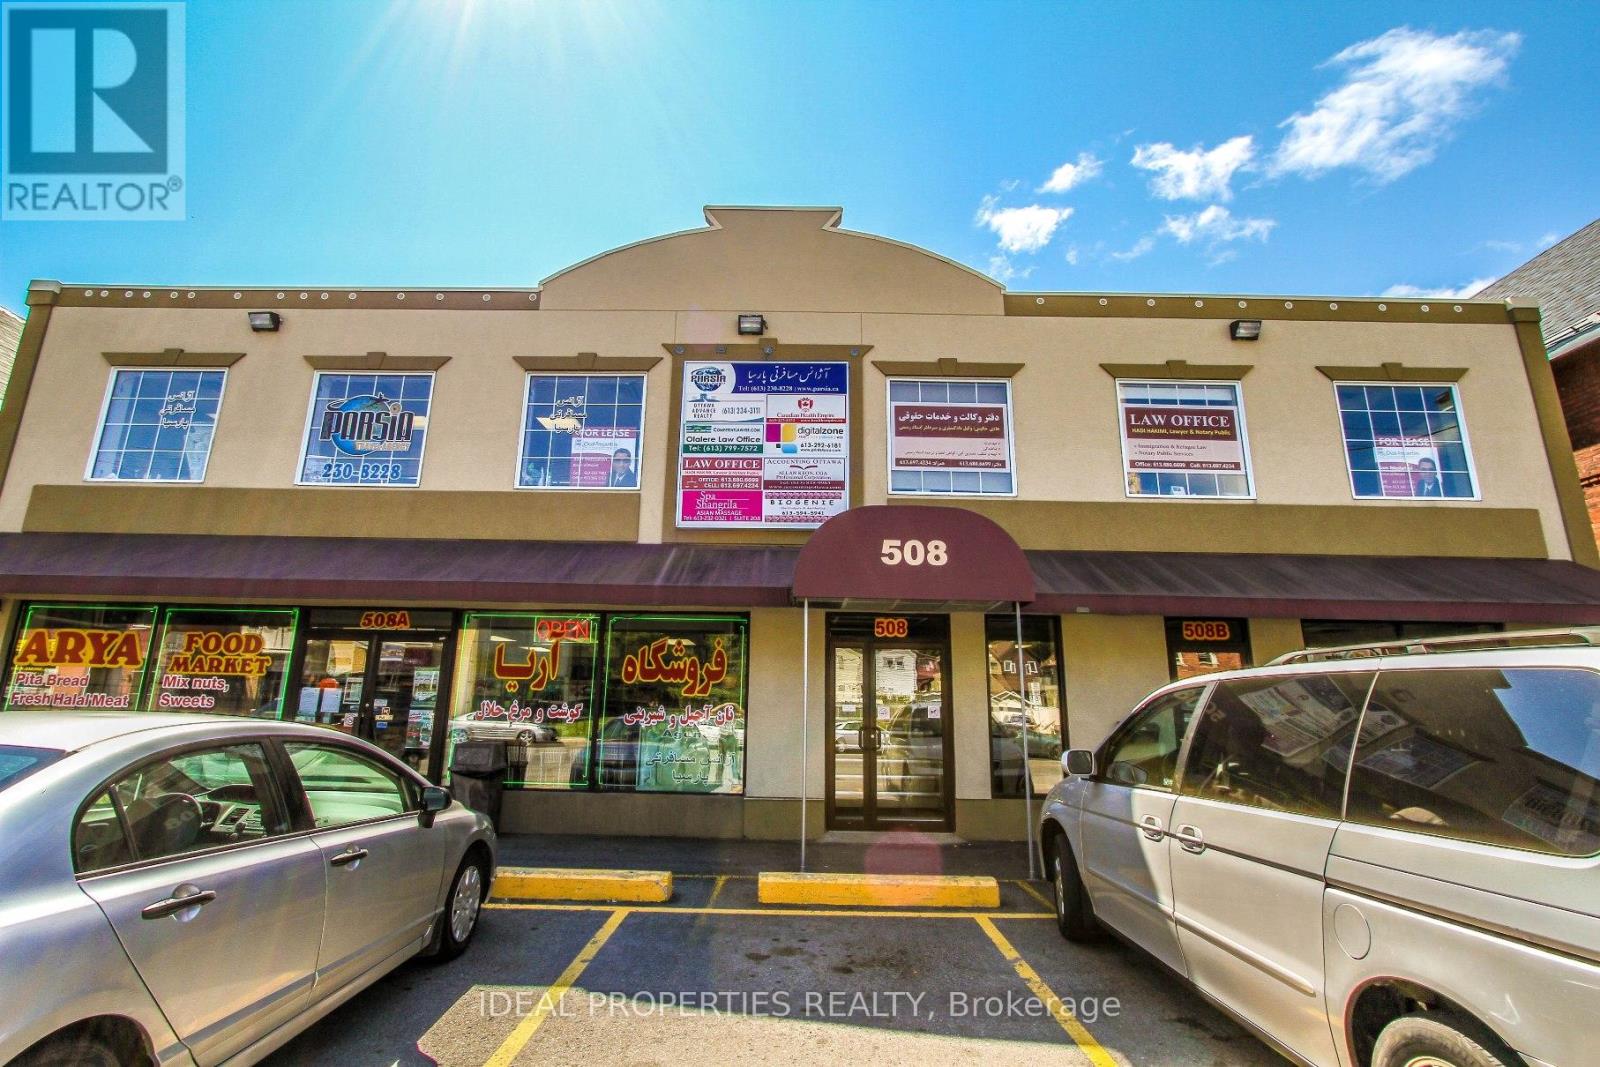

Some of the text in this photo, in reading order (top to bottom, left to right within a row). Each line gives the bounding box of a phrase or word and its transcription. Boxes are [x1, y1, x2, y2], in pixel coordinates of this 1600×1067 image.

[748, 366, 831, 384] آژانس مسافرتی پارسیا
[722, 407, 736, 415] (613)
[898, 411, 924, 422] حقوقی
[926, 412, 952, 421] خدمات
[953, 415, 958, 423] و
[984, 413, 999, 424] دفتر
[1130, 414, 1231, 428] LAW OFFICE
[601, 429, 630, 437] LEASE
[797, 426, 844, 437] digitalzone
[1378, 437, 1400, 446] FOR
[321, 463, 402, 480] 230-8228
[685, 459, 760, 469] LAW OFFICE
[700, 490, 716, 502] Spa
[695, 500, 738, 512] Shangrila
[880, 539, 948, 566] 508
[360, 611, 411, 629] 508A
[874, 617, 908, 638] 508
[536, 619, 590, 641] OPEN
[1182, 621, 1231, 641] 508B
[13, 628, 144, 668] ARYA
[182, 631, 265, 656] FOOD
[168, 655, 272, 677] MARKET
[494, 630, 565, 692] آریا
[622, 637, 728, 697] فروشگاه
[14, 672, 90, 688] Pita Bread
[162, 674, 230, 692] Mix nuts,
[10, 692, 129, 708] Fresh Halal Meat
[159, 693, 216, 708] Sweets
[474, 699, 584, 724] گوشت و مرغ حلال
[623, 704, 735, 730] نان آجیل و شیرینی
[645, 750, 696, 767] مسافرتی
[672, 769, 709, 786] پارسیا
